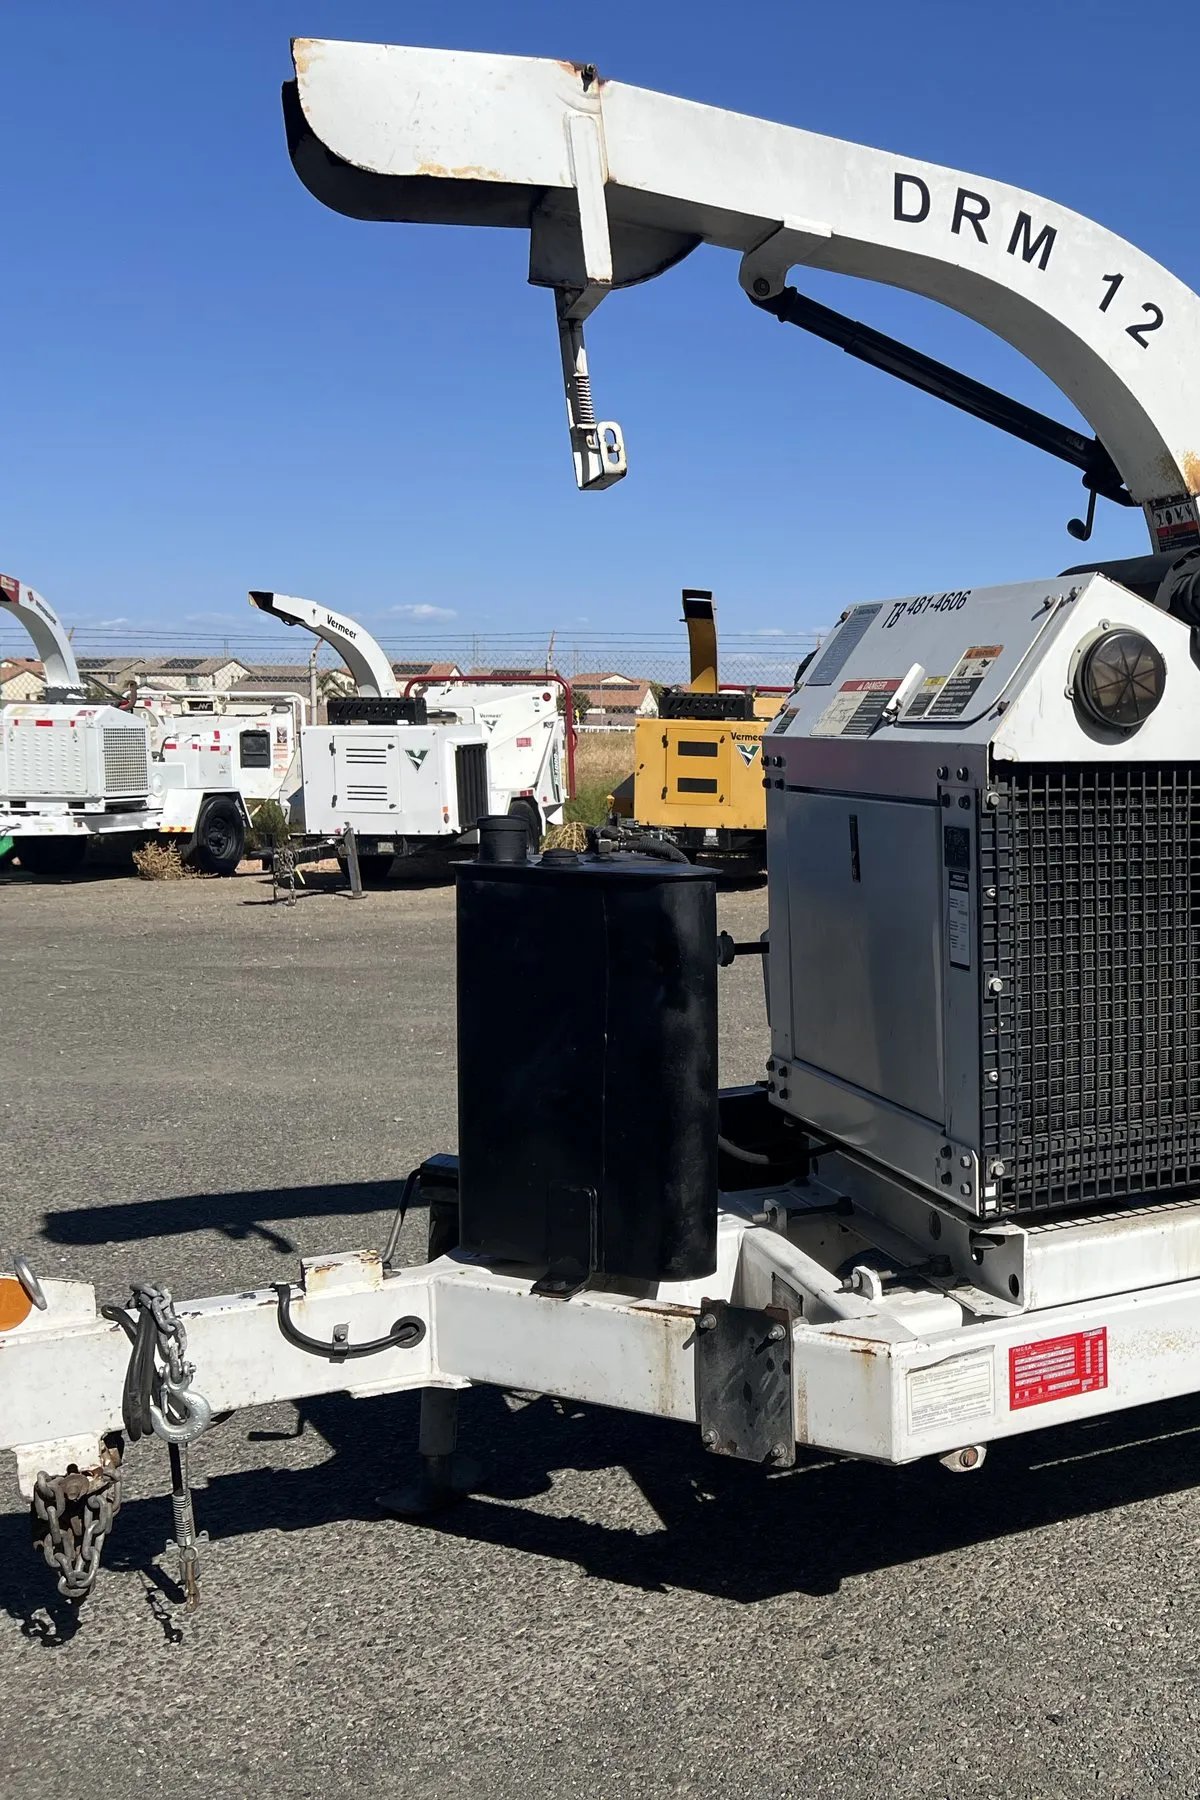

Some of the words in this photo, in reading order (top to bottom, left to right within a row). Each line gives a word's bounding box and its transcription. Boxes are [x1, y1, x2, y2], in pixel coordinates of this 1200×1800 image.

[893, 172, 1058, 271] DRM
[1098, 272, 1164, 349] 12
[906, 590, 972, 616] 481-4606
[327, 614, 357, 639] Vermeer
[862, 681, 888, 690] DANGER
